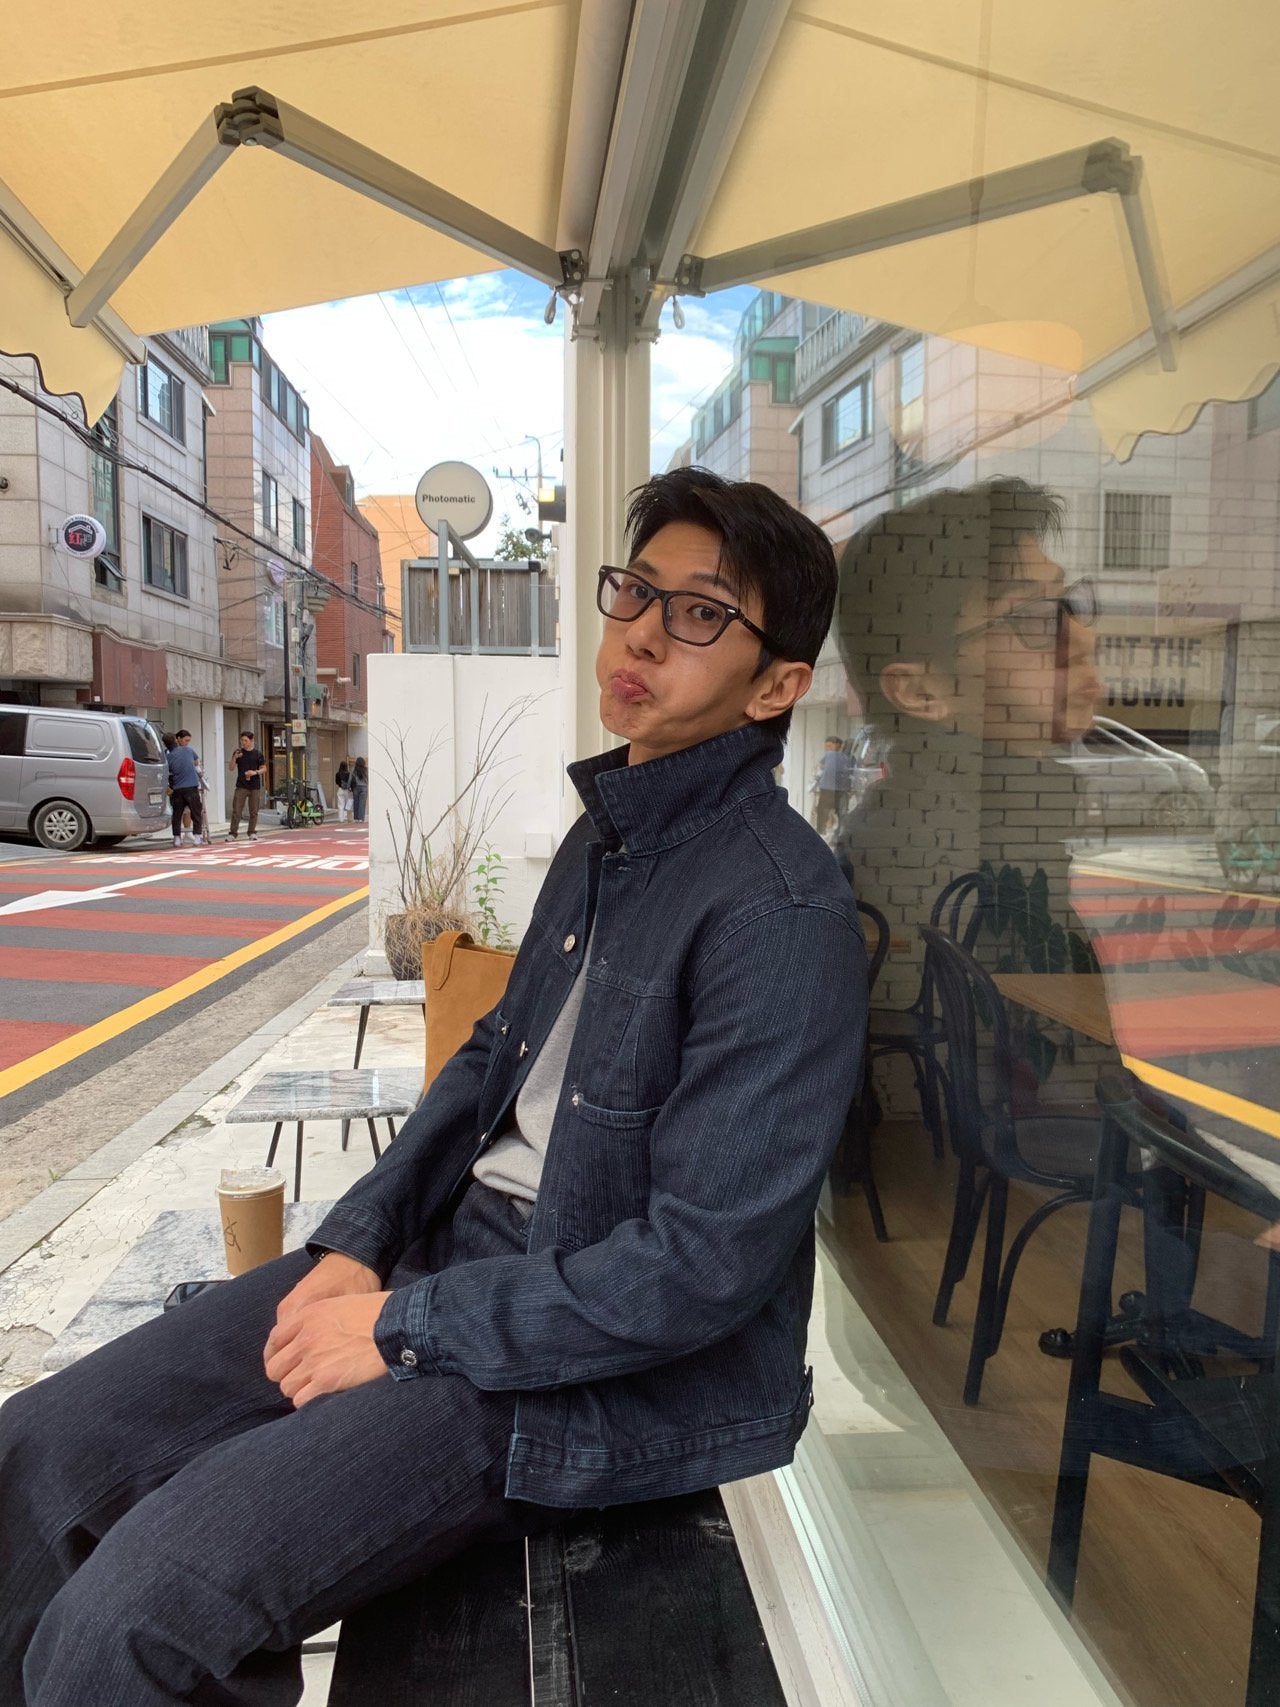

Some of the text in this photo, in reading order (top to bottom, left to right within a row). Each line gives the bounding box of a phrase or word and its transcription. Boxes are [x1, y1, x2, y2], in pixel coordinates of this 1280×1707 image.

[422, 494, 476, 503] Photomatic
[1094, 636, 1202, 668] HIT THE
[1104, 677, 1185, 707] TOWN
